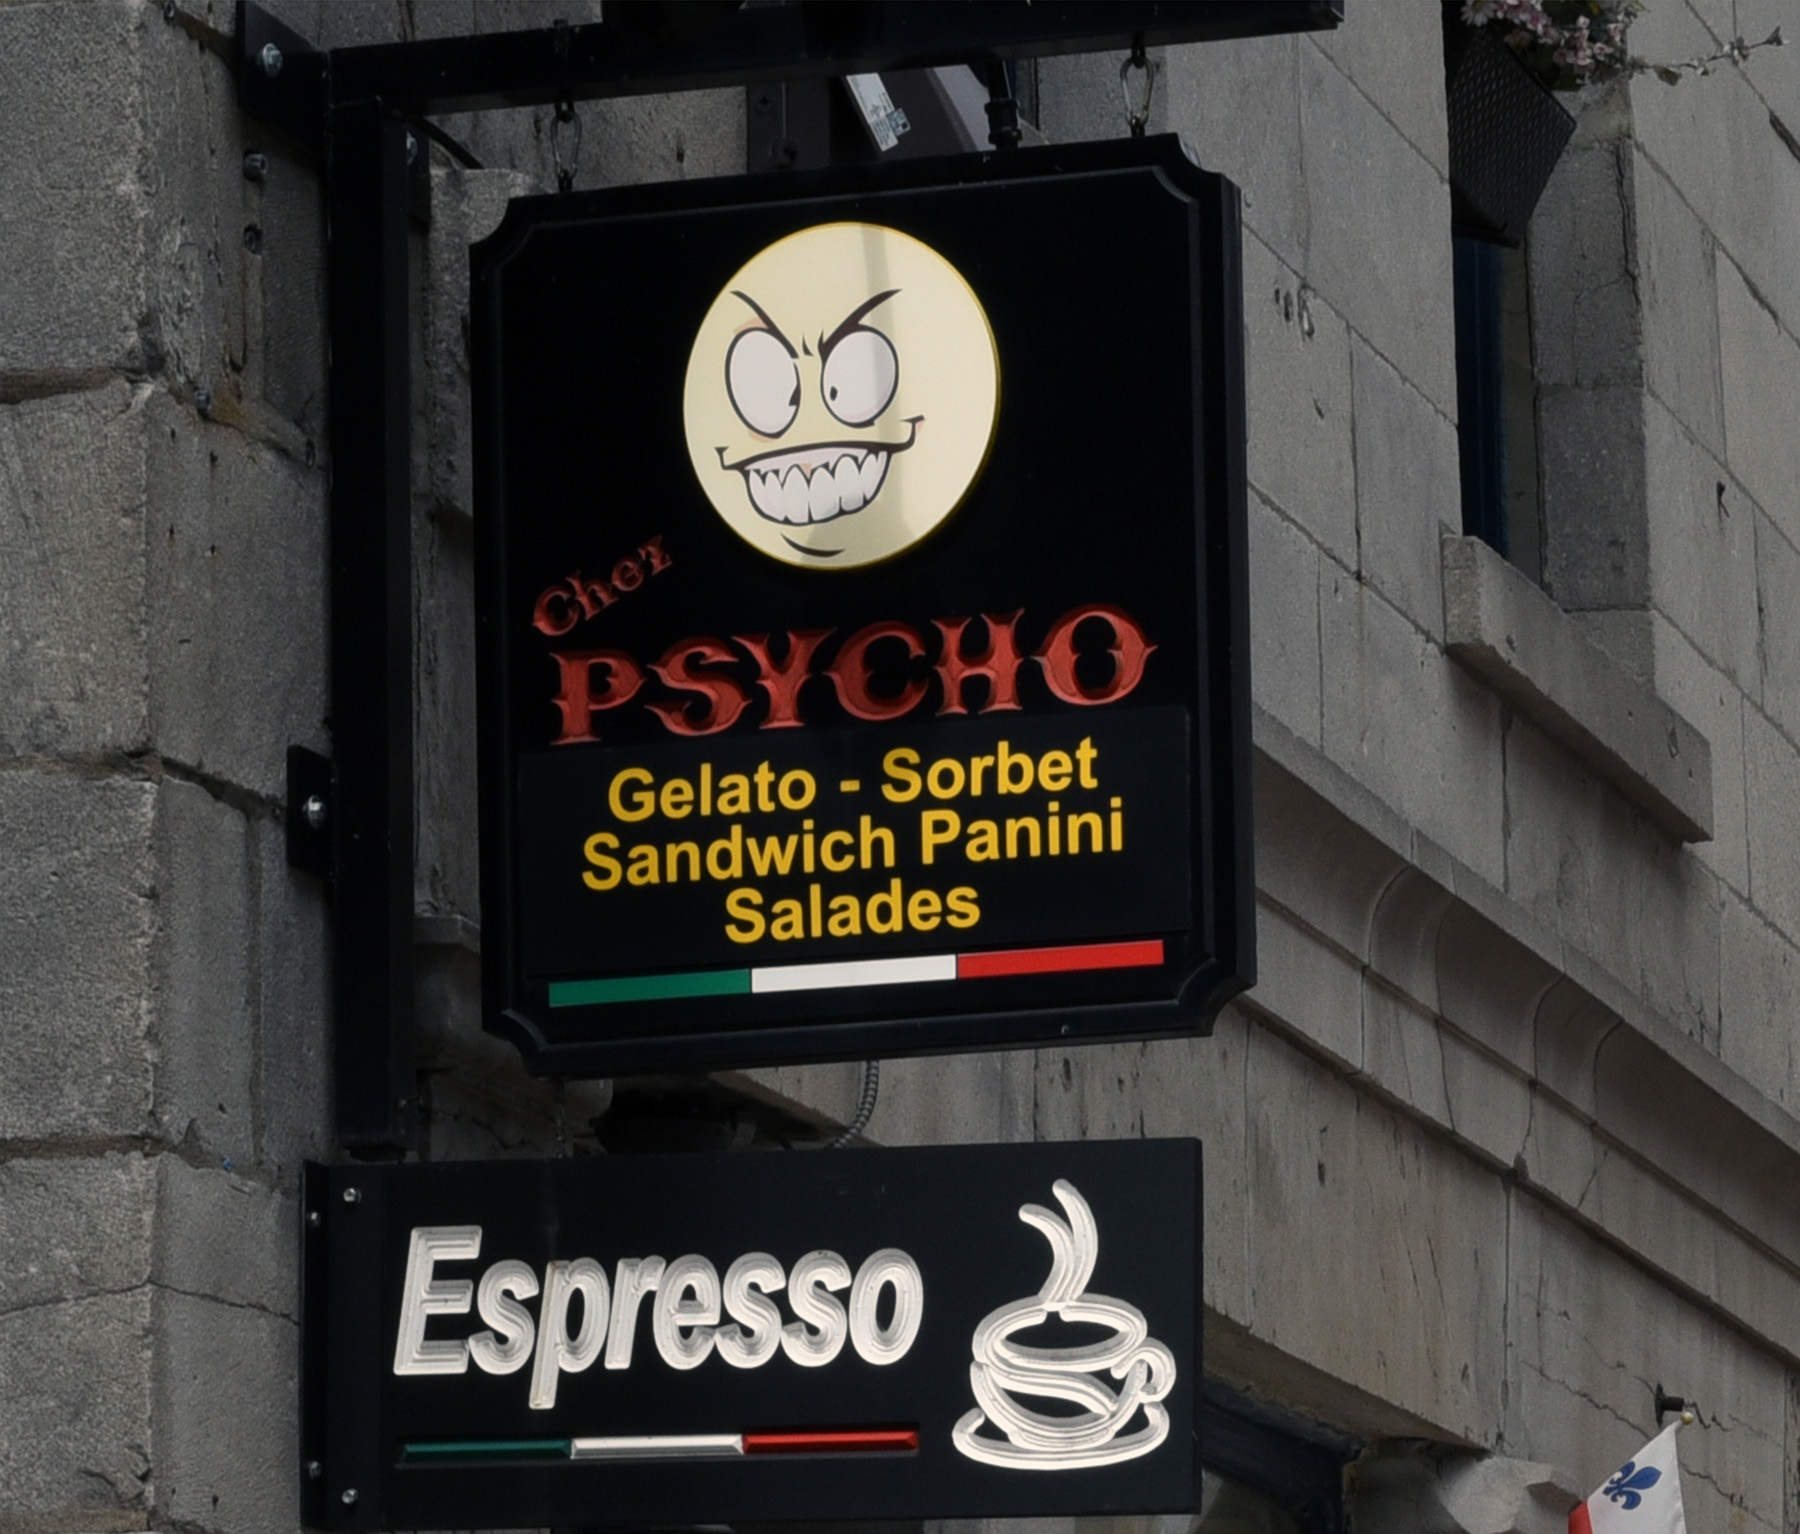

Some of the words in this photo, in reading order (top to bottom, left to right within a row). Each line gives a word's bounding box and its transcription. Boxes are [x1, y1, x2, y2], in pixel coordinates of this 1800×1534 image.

[531, 534, 674, 638] Chez
[548, 603, 1160, 747] PSYCHO
[607, 761, 816, 823] Gelato
[881, 737, 1098, 804] Sorbet
[581, 816, 896, 893] Sandwich
[921, 799, 1125, 866] Panini
[725, 880, 982, 946] Salades
[393, 1225, 925, 1409] Espresso
